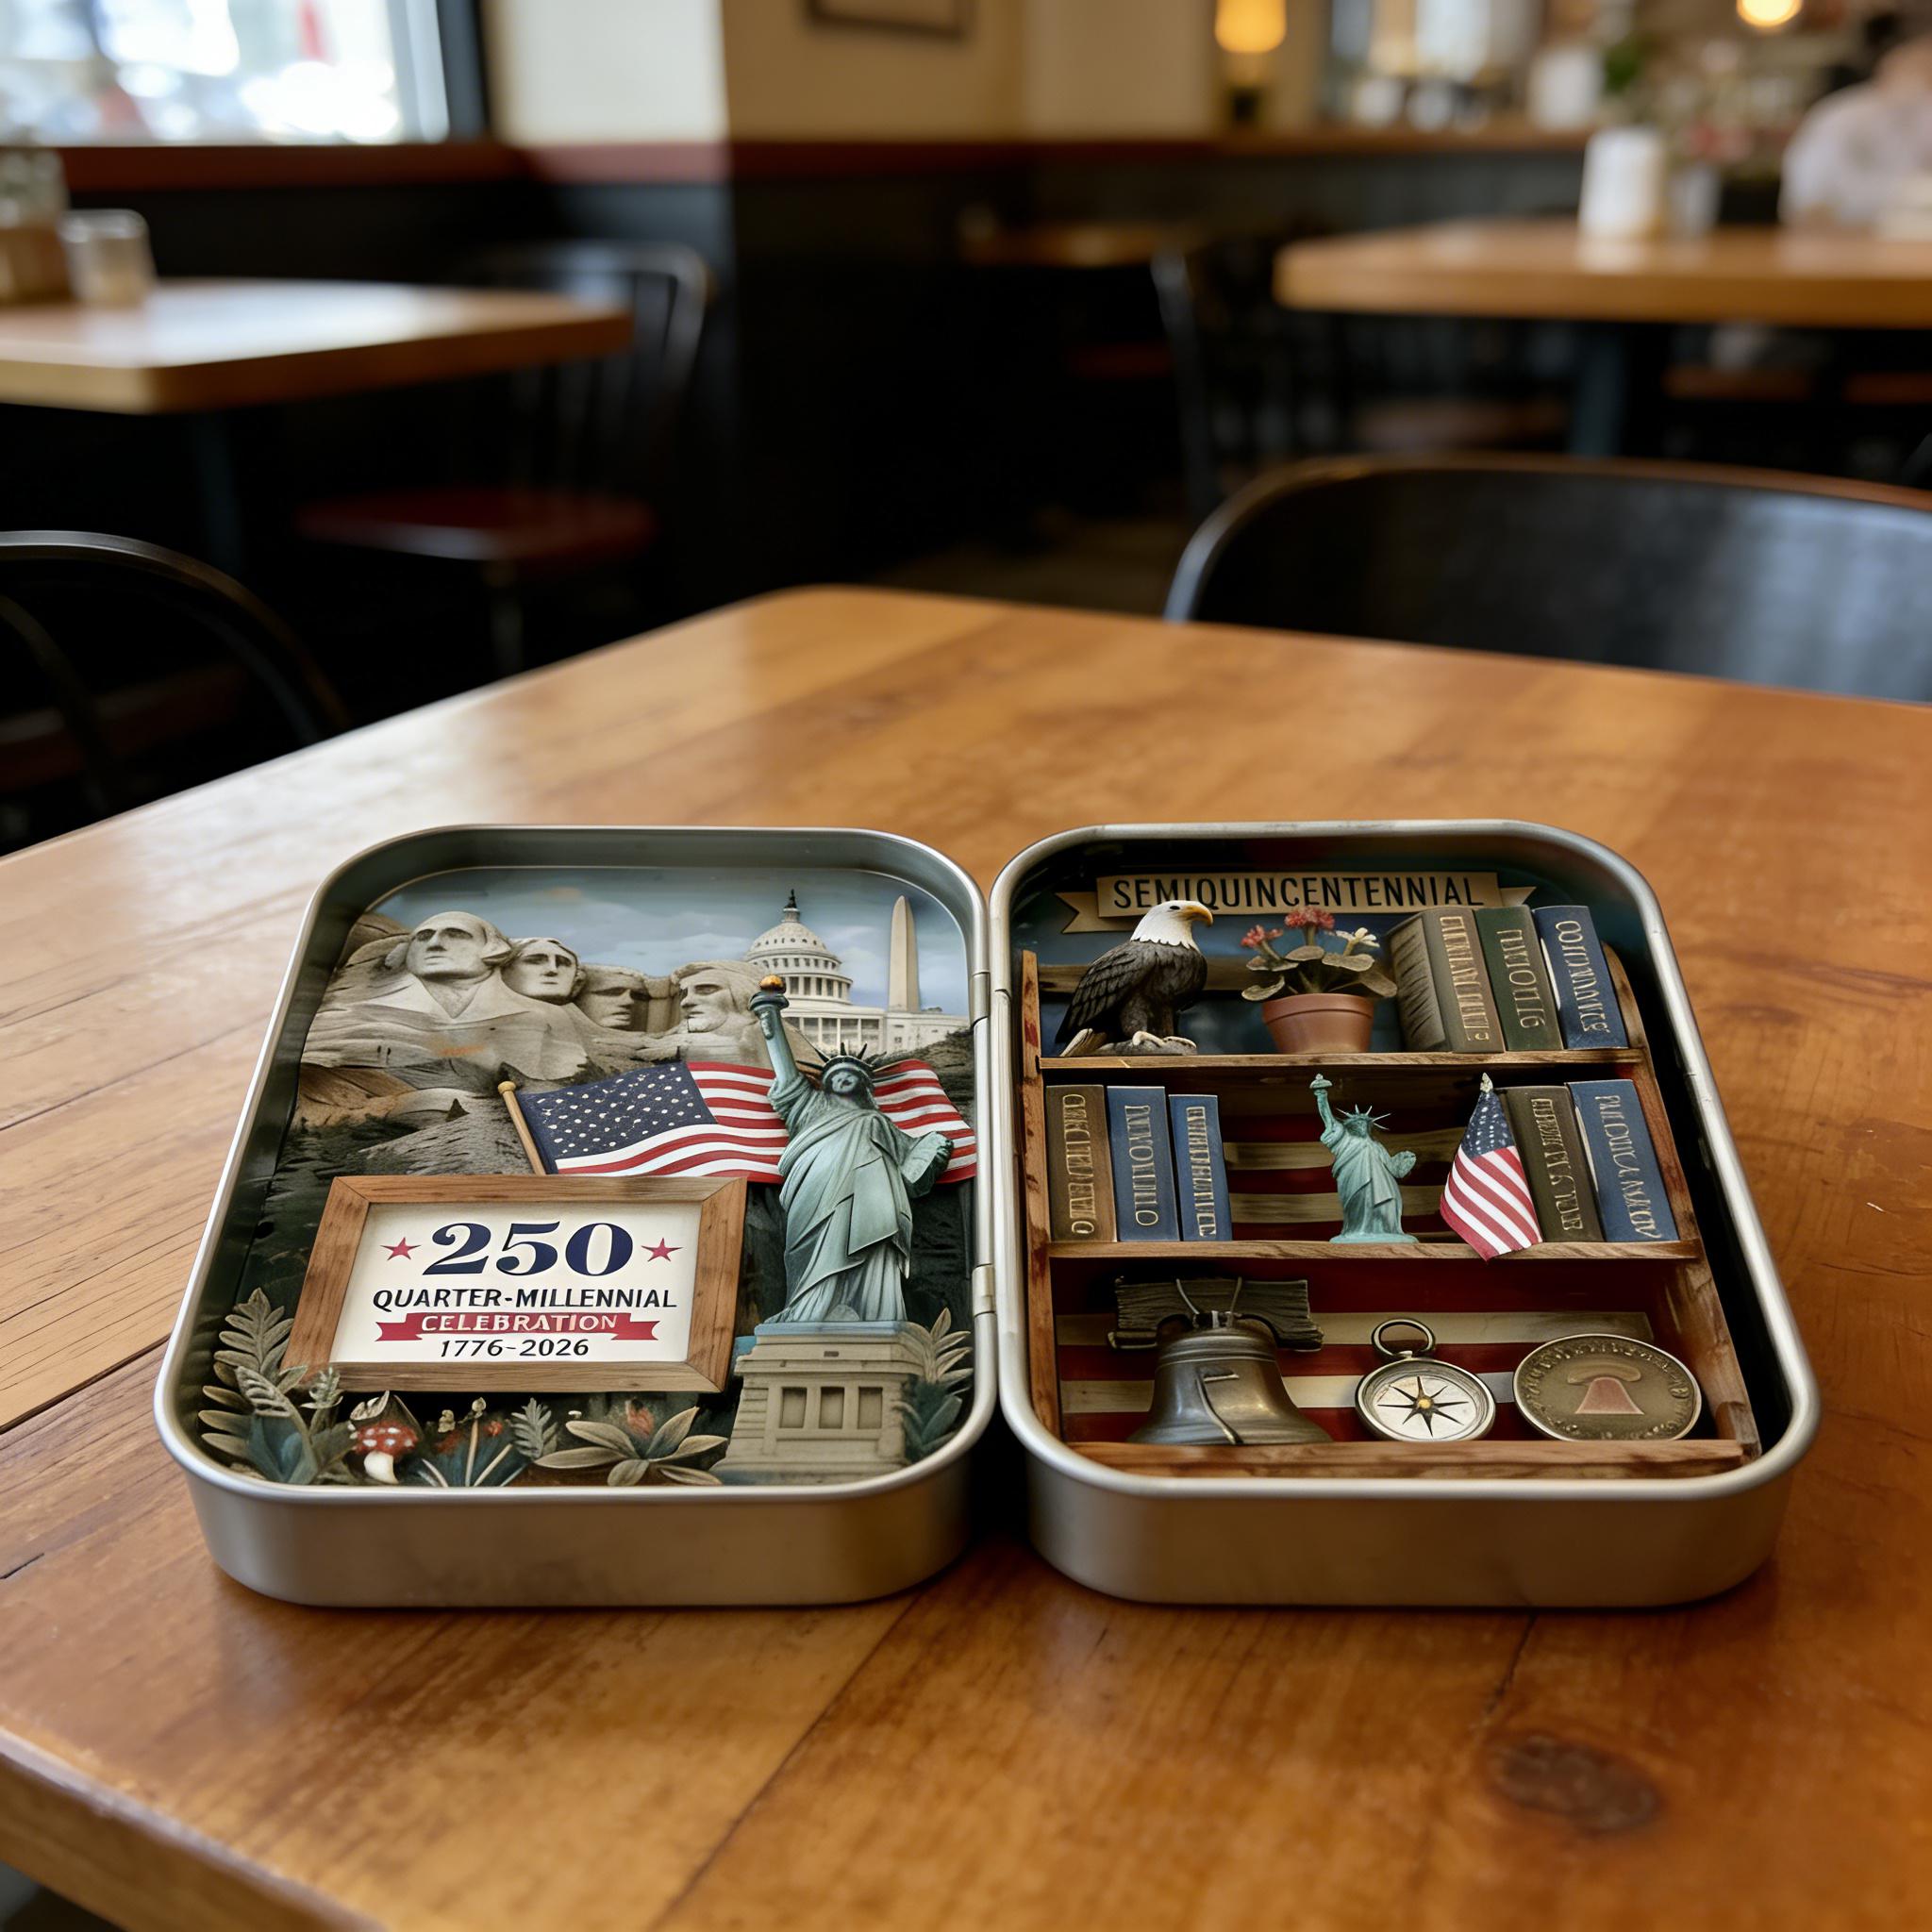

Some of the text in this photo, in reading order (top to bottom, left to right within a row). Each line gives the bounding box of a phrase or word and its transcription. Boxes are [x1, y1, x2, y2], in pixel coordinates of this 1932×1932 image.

[1113, 875, 1484, 909] SEMIQUINCENTENNIAL
[422, 1221, 633, 1276] 250
[373, 1289, 677, 1312] QUARTER-MILLENNIAL
[421, 1314, 618, 1333] CELEBRATION
[441, 1339, 590, 1357] 1776-2026
